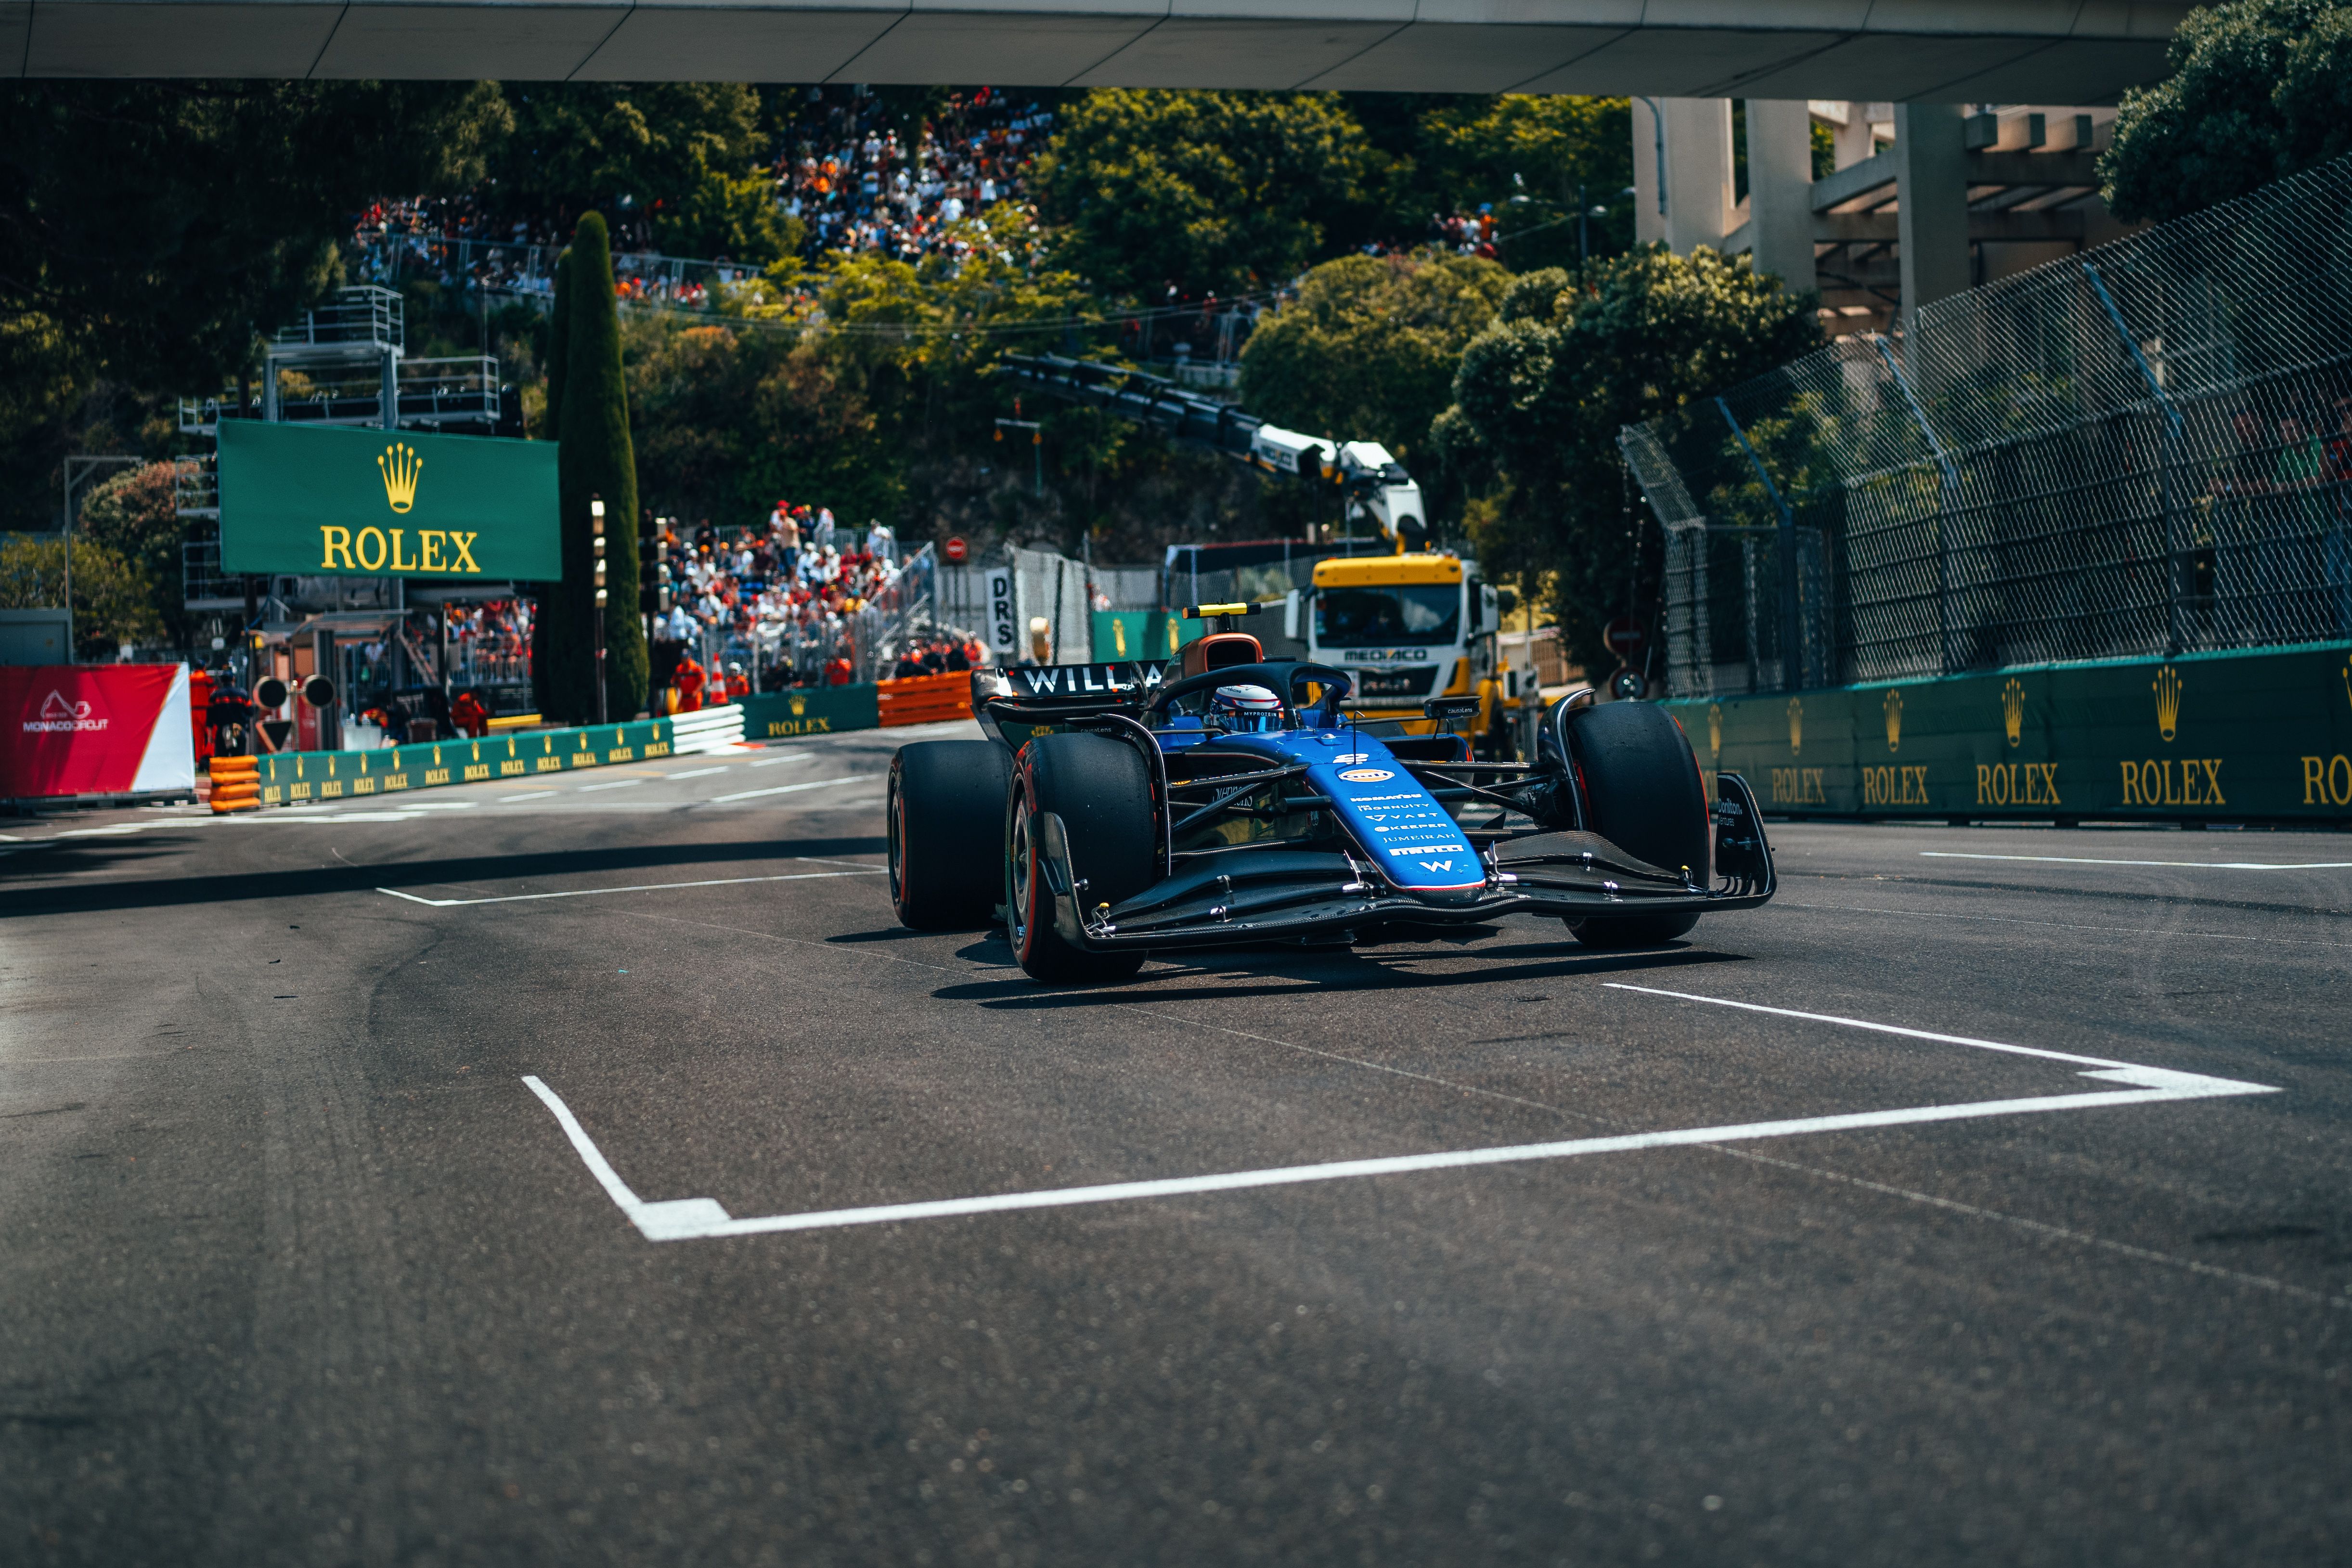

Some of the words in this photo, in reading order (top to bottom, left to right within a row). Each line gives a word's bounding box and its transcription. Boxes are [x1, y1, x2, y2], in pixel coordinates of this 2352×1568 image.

[320, 525, 481, 573] ROLEX
[993, 578, 1012, 645] DRS
[769, 718, 830, 737] ROLEX
[609, 747, 633, 762] ROLEX
[645, 742, 670, 757] ROLEX
[537, 757, 561, 771] ROLEX
[572, 752, 596, 767] ROLEX
[465, 764, 490, 779] ROLEX
[501, 760, 525, 775] ROLEX
[426, 768, 450, 785] ROLEX
[1977, 763, 2061, 805] ROLEX
[2120, 759, 2226, 805] ROLEX
[1772, 768, 1825, 803] ROLEX
[1863, 766, 1929, 804] ROLEX
[1350, 793, 1422, 802] KOMATSU
[1383, 833, 1455, 843] JUMEIRAH
[1389, 844, 1464, 856] PIRELLI
